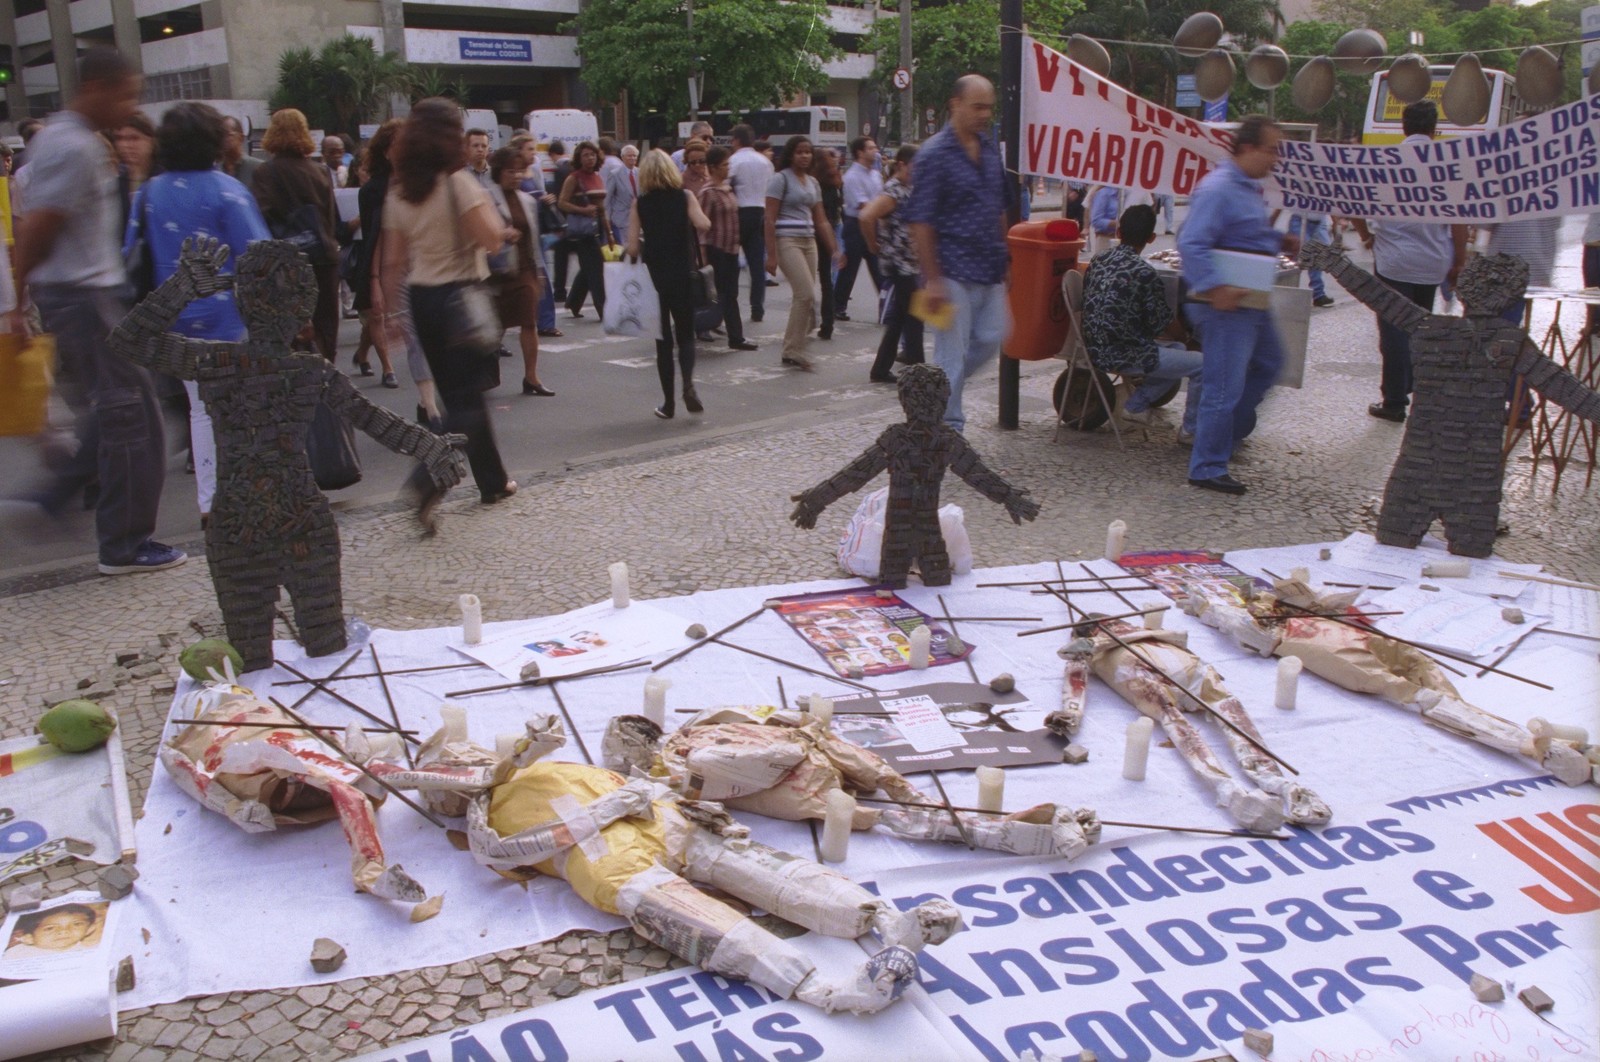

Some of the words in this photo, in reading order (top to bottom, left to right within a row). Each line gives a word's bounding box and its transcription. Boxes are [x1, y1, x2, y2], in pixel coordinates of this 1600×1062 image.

[1028, 124, 1164, 190] VIGÁRIO
[1322, 145, 1402, 166] VEZES
[1413, 121, 1538, 163] VITIMAS
[1429, 163, 1463, 183] DE
[1476, 127, 1596, 178] POLICIA
[1273, 175, 1383, 202] VAIDADE
[1394, 185, 1448, 203] DOS
[1464, 148, 1597, 201] ACORDOS
[1507, 184, 1559, 216] DAS
[917, 886, 1402, 1005] Ansiosas
[1412, 869, 1494, 911] e
